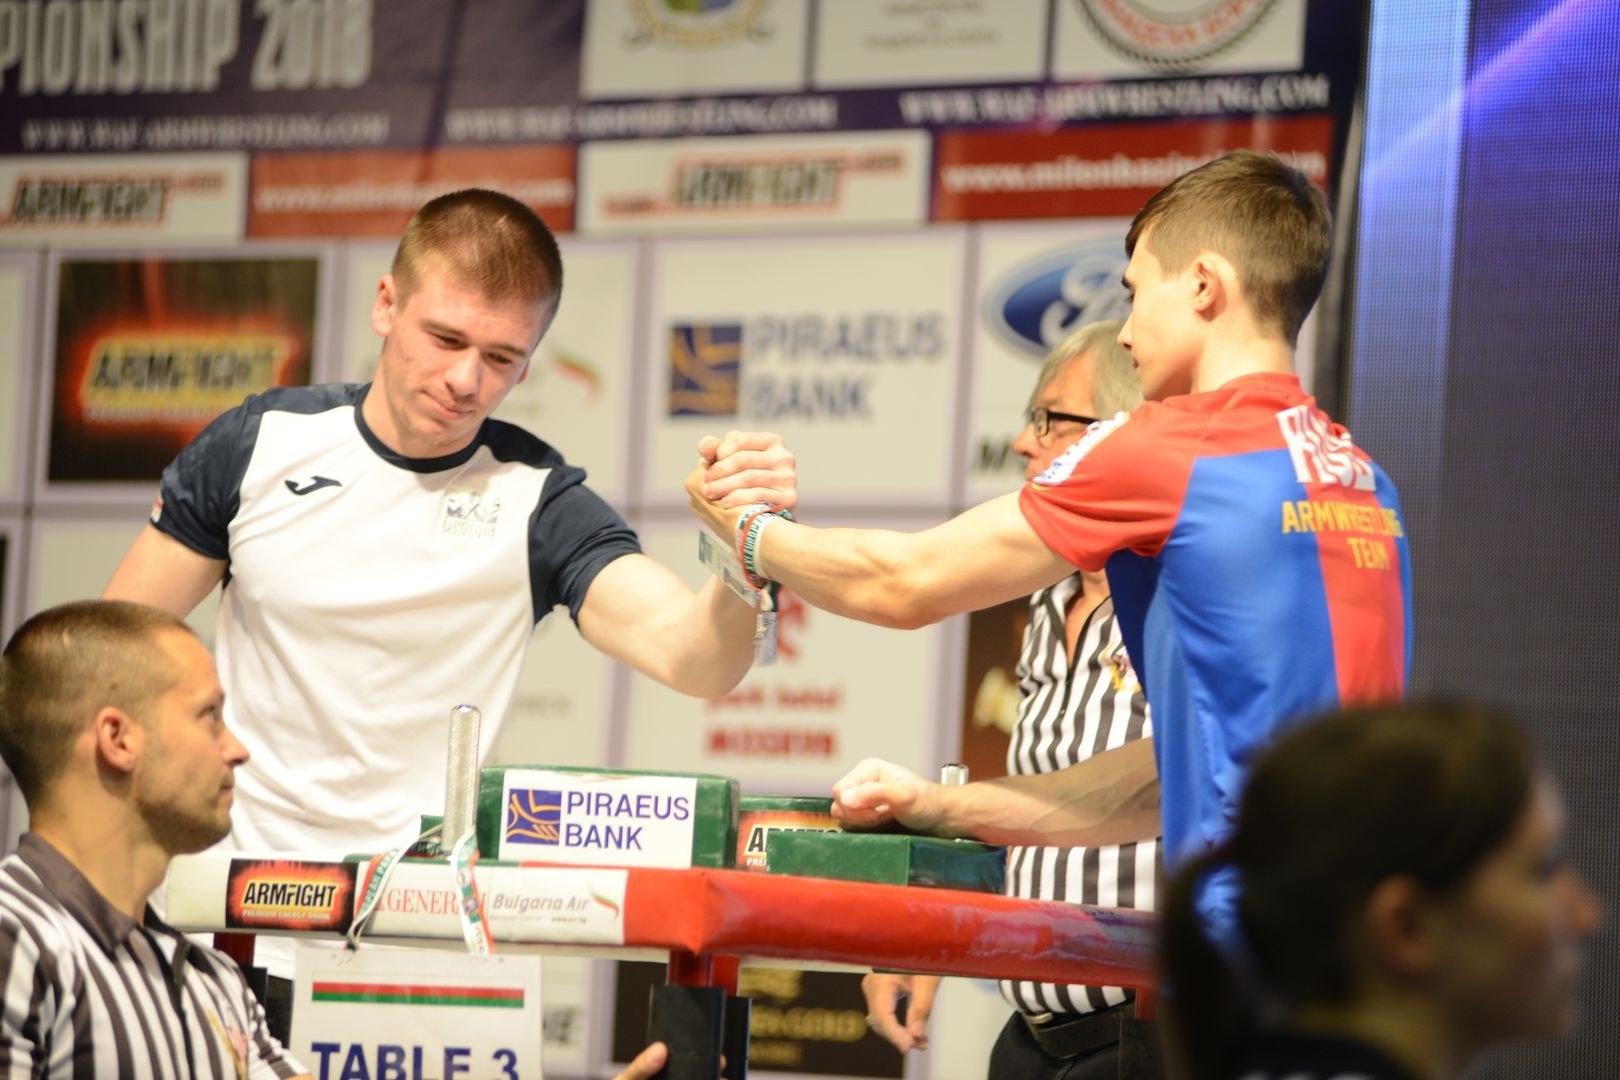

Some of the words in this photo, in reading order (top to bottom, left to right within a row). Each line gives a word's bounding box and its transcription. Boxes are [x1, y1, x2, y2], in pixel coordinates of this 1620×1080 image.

[751, 310, 946, 361] PIRAEUS
[750, 372, 874, 419] BANK
[1346, 526, 1391, 570] TEAM
[566, 790, 690, 821] PIRAEUS
[564, 823, 643, 851] BANK
[243, 882, 337, 907] ARMFIGHT
[493, 894, 563, 914] Bulgaria
[567, 896, 590, 911] Air
[311, 1042, 472, 1080] TABLE
[492, 1048, 520, 1080] 3
